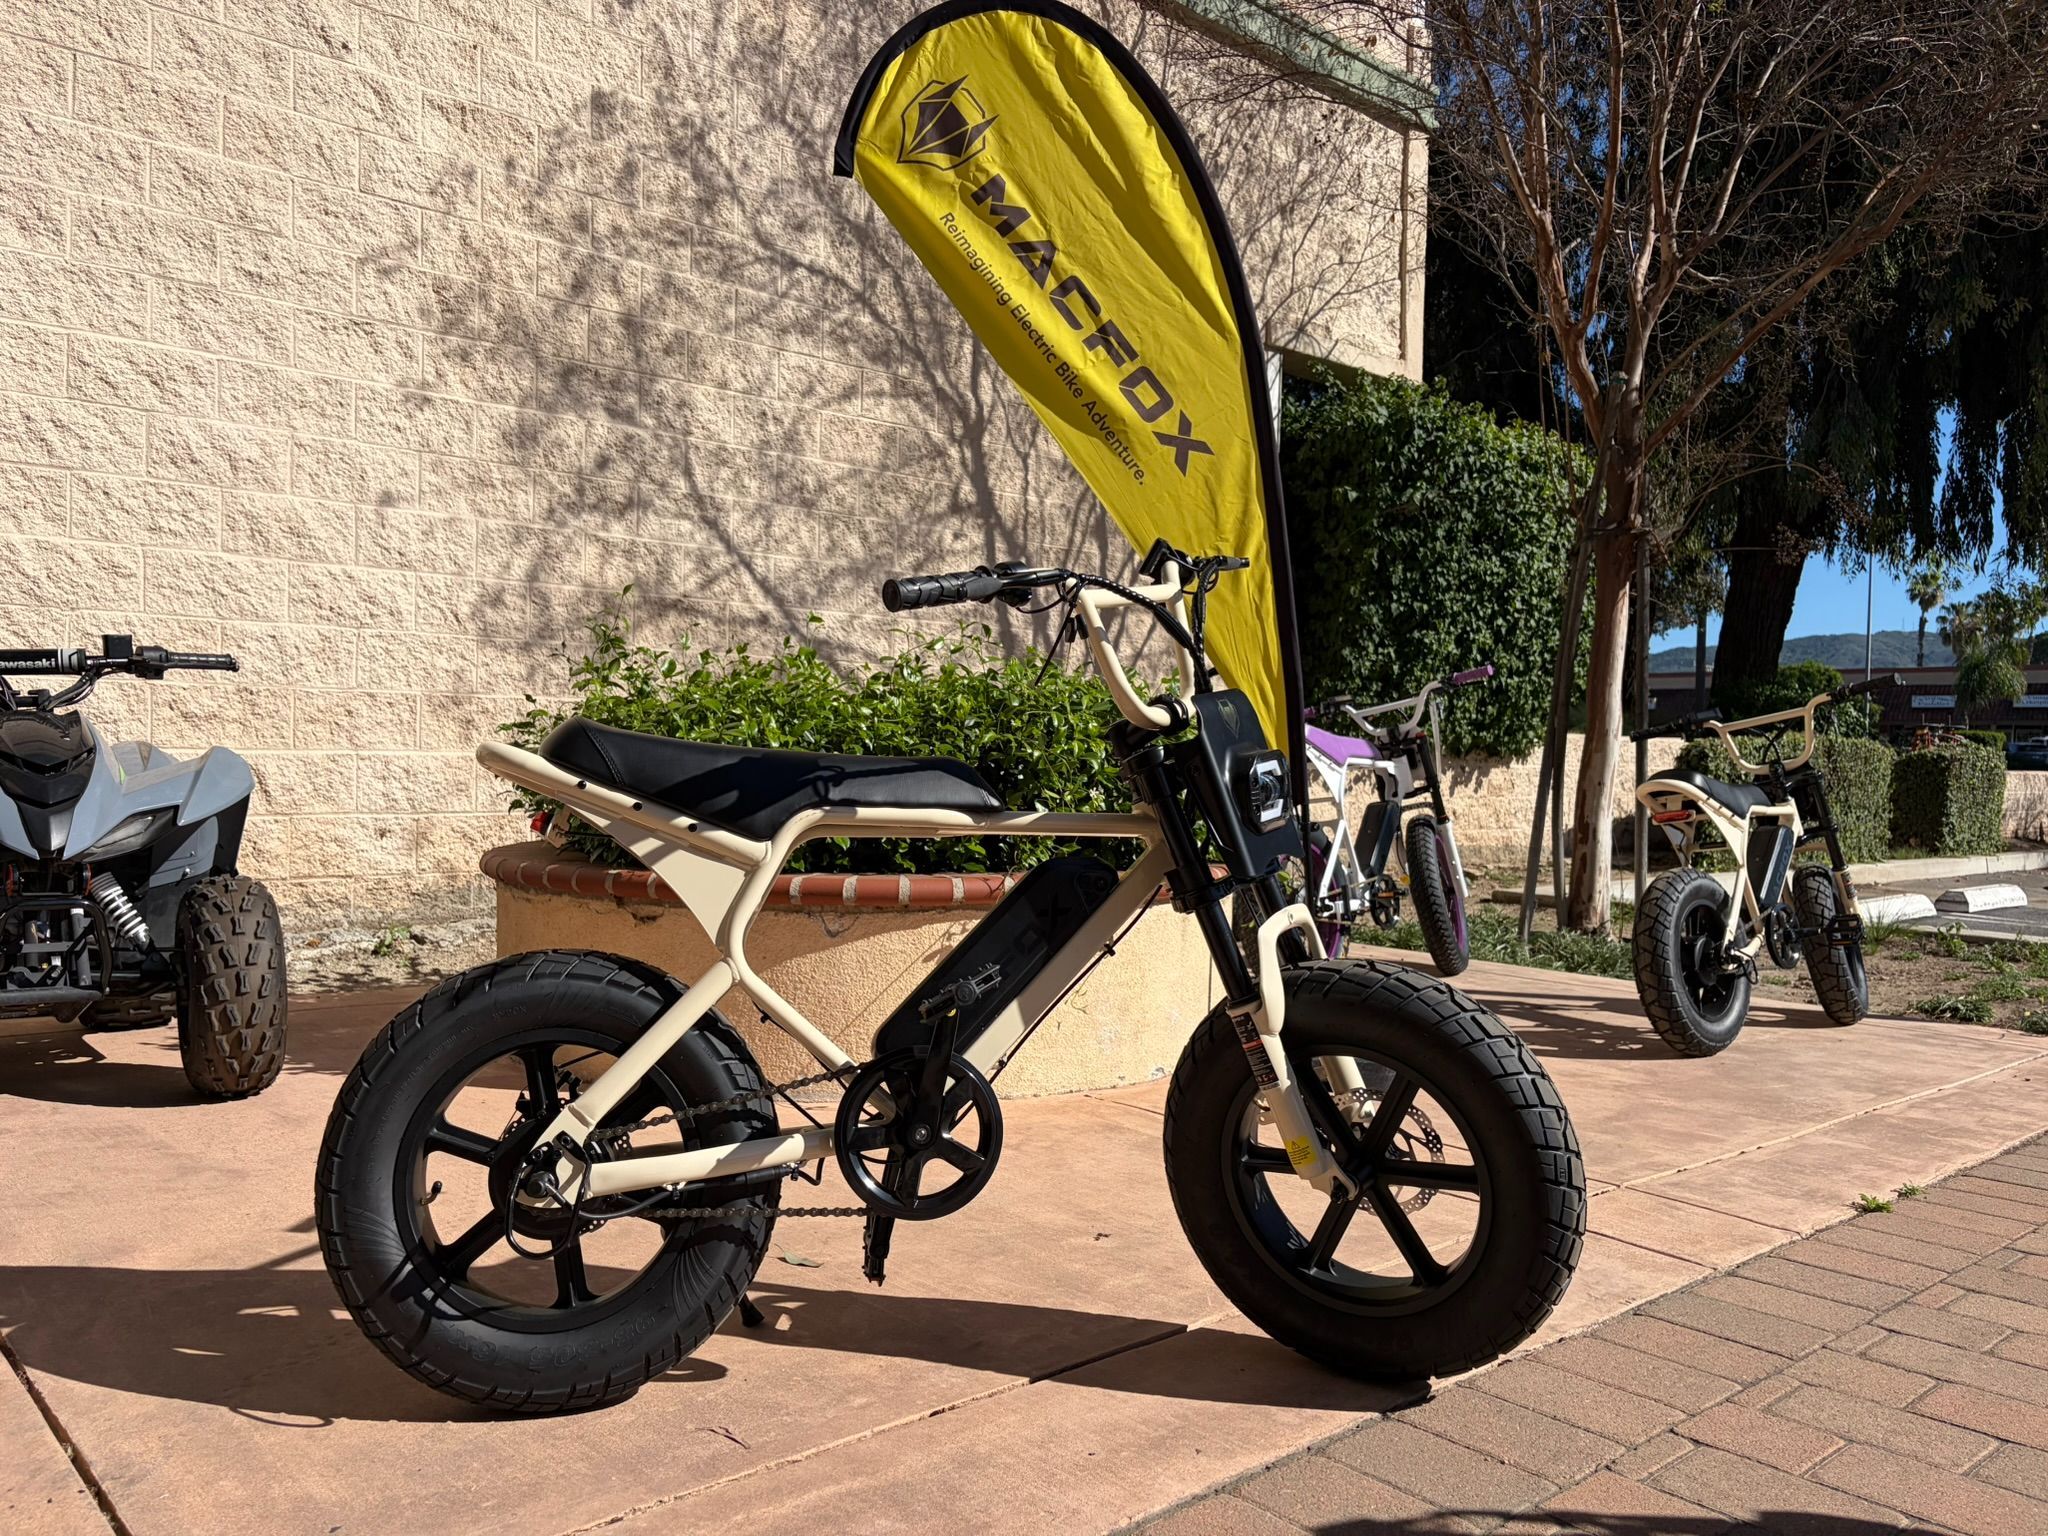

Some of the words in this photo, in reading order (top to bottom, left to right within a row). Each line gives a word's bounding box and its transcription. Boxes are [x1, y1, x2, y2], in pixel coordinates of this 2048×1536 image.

[939, 211, 1012, 306] Reimagining
[1011, 304, 1057, 364] Electric
[1055, 363, 1084, 399] Bike
[1081, 400, 1147, 486] Adventure.
[970, 173, 1215, 477] MACFOX
[0, 658, 56, 669] awasaki
